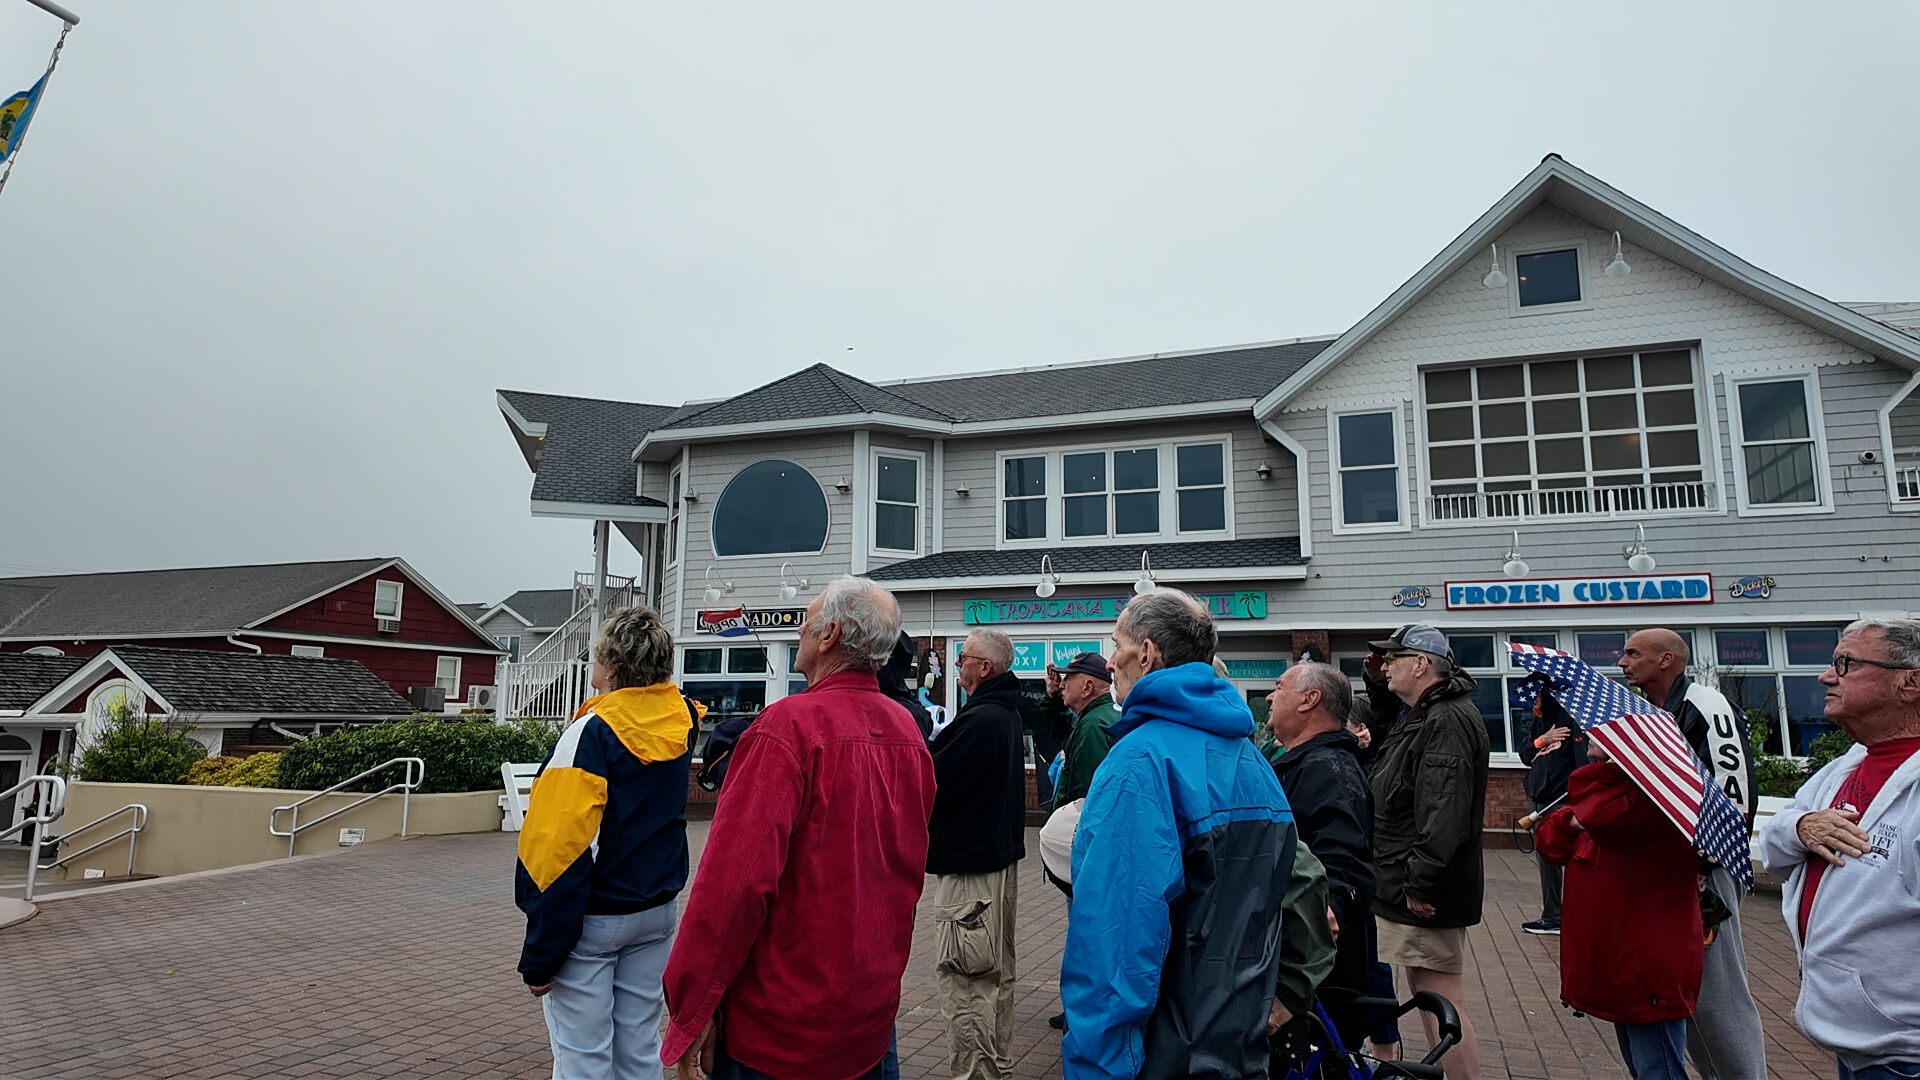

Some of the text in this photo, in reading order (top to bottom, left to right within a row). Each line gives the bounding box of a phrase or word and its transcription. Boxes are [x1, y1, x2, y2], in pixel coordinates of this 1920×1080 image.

[1392, 586, 1431, 608] Dickey's
[1450, 579, 1709, 604] FROZEN CUSTARD
[1729, 575, 1776, 599] Dickey's
[994, 599, 1102, 620] TROPICANA
[1014, 656, 1038, 666] OXY
[1228, 668, 1270, 677] OUTIQUE
[1713, 713, 1744, 805] USA
